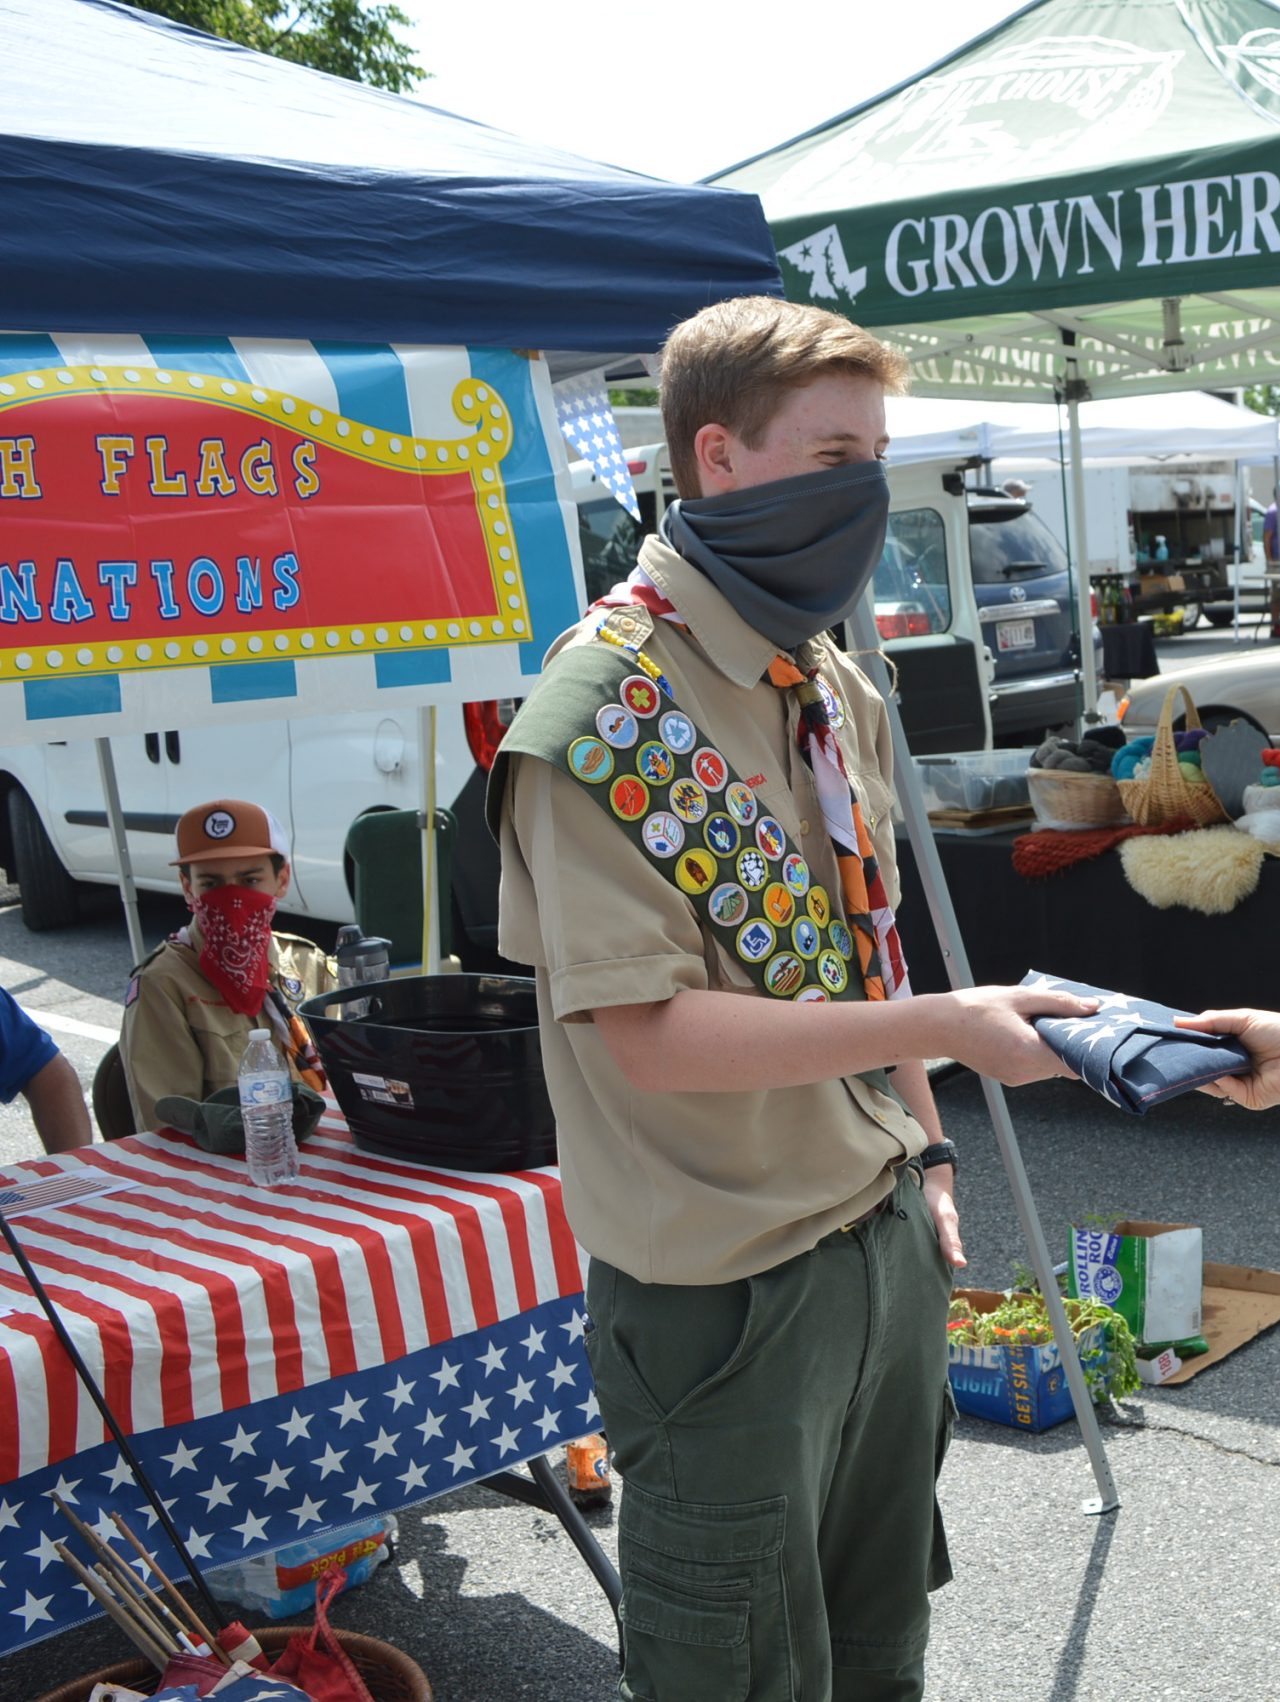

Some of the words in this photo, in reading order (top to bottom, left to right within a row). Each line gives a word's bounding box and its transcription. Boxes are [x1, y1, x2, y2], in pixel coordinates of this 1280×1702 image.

[885, 191, 1126, 298] GROWN
[95, 433, 321, 499] FLAGS
[0, 552, 300, 624] NATIONS
[953, 1376, 1004, 1397] LIGHT
[1011, 1362, 1028, 1390] SIX
[1015, 1392, 1032, 1425] GET
